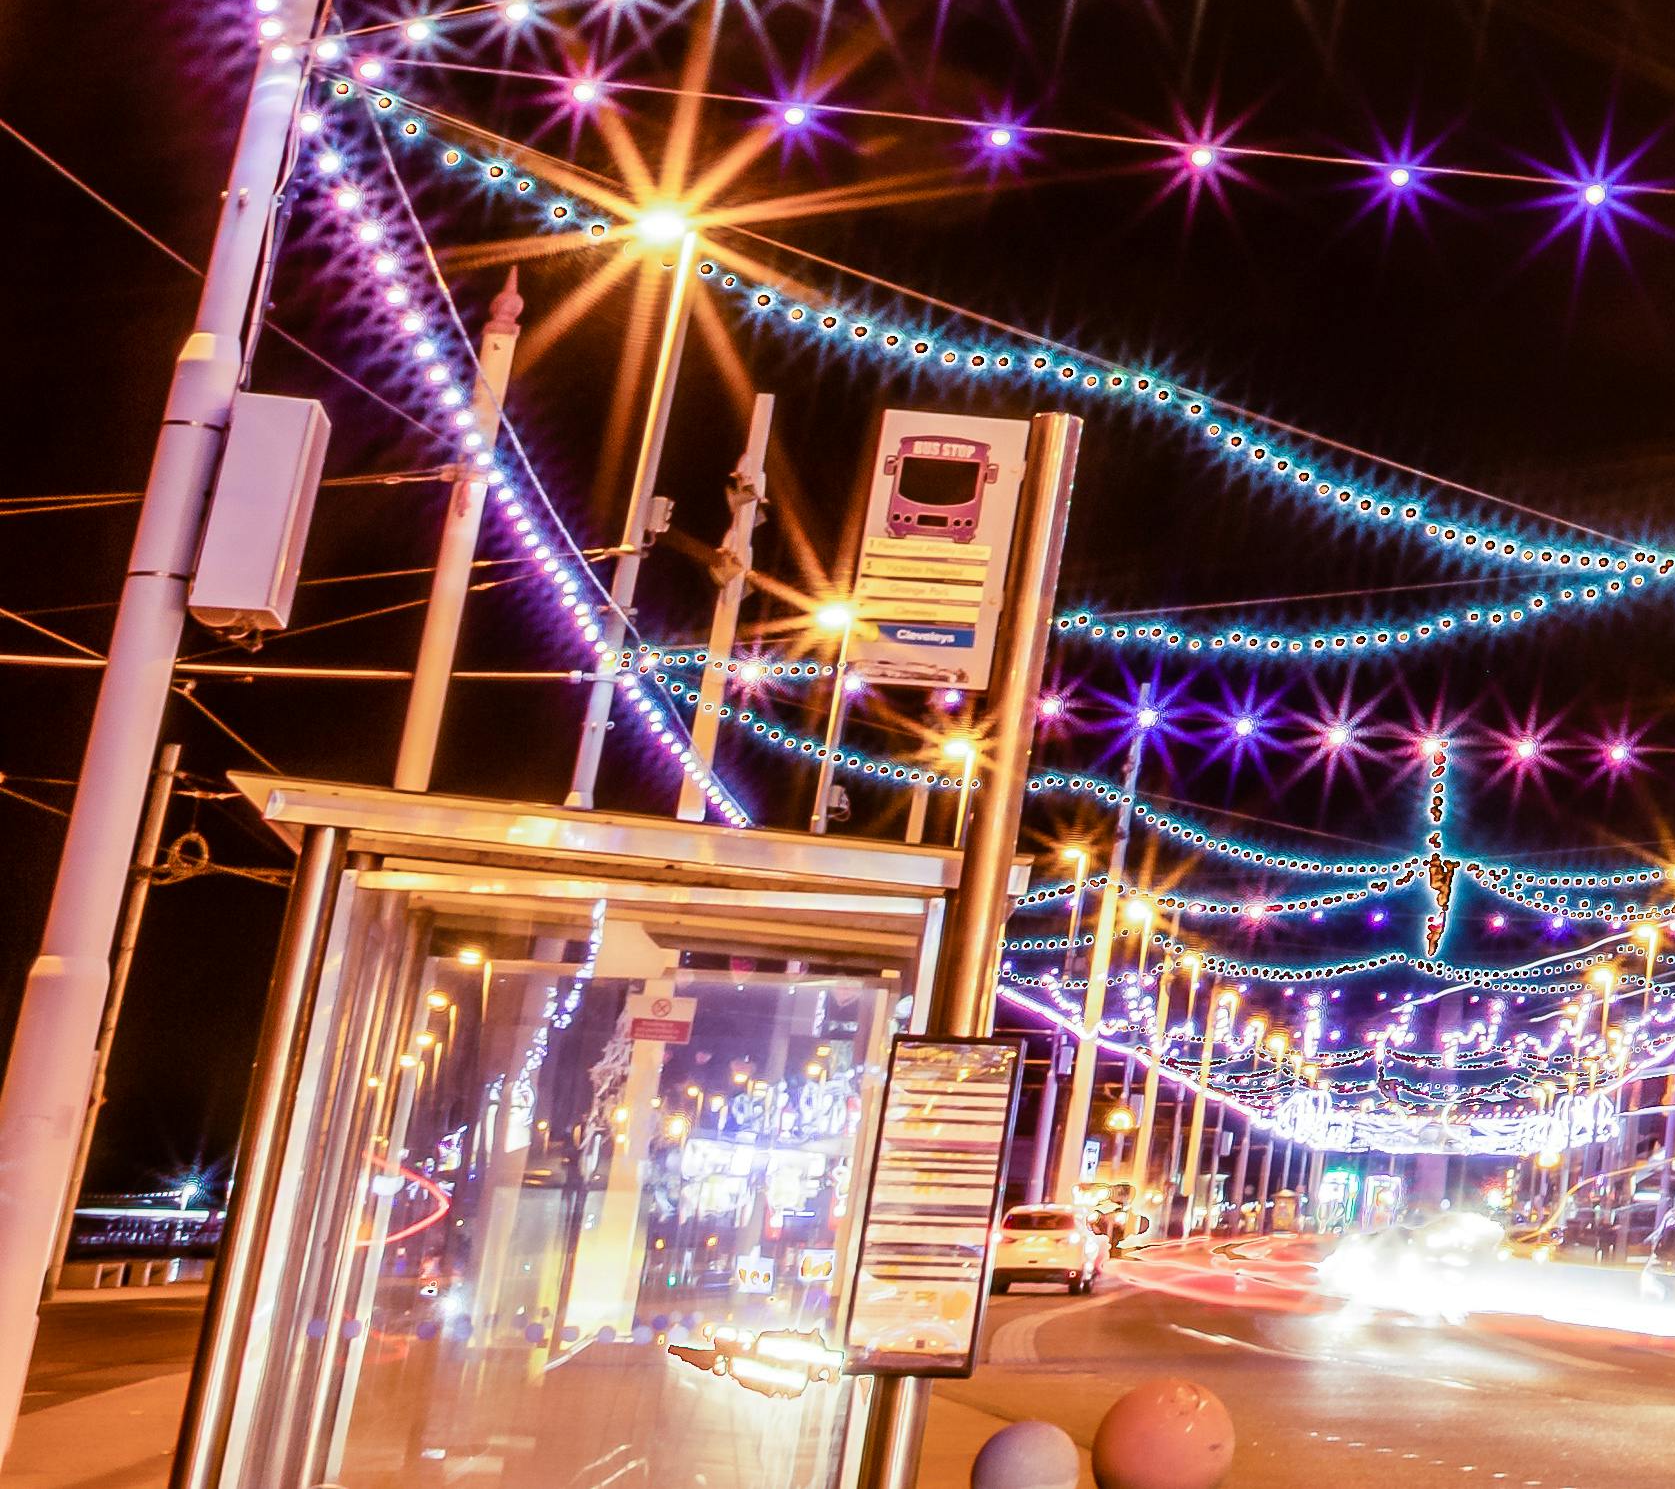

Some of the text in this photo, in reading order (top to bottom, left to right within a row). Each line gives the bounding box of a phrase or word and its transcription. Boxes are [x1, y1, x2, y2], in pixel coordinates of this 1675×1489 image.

[912, 440, 976, 458] BUS STOP
[896, 628, 956, 644] Cleveleys
